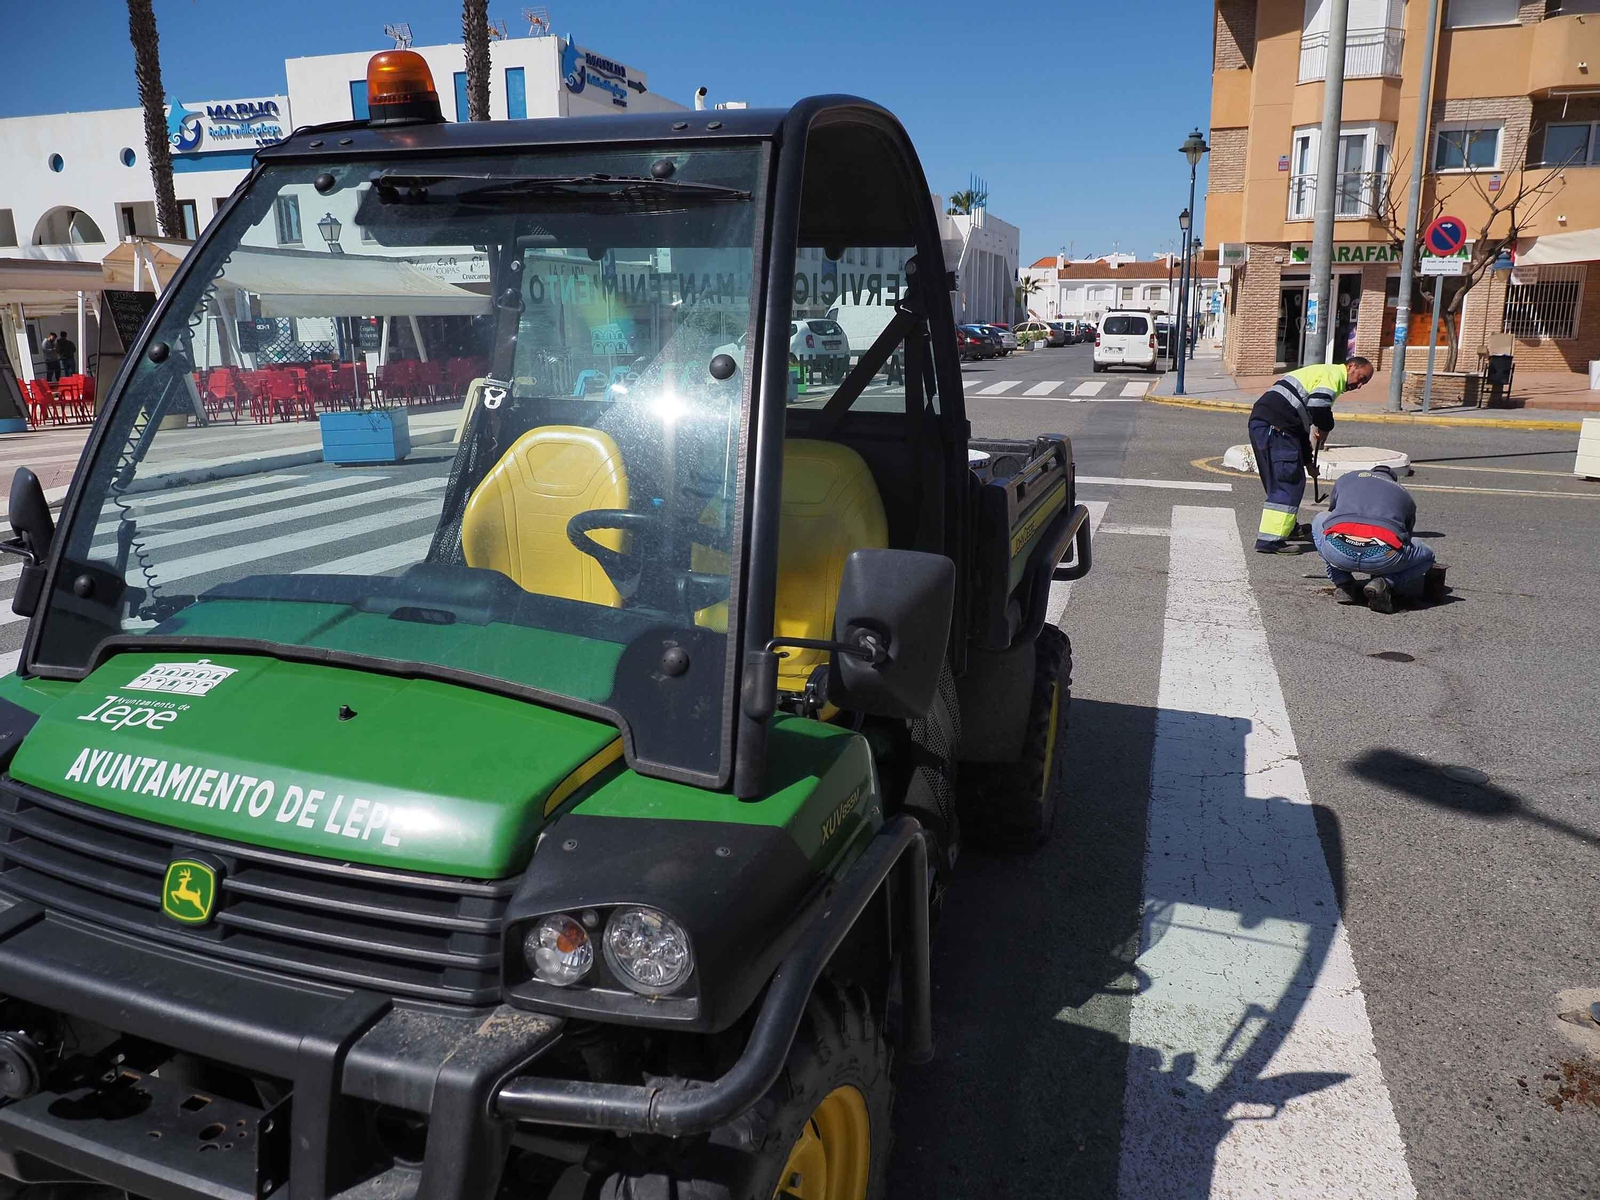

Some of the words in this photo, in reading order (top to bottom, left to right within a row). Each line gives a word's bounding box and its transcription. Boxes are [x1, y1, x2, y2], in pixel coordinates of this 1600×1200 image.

[436, 266, 461, 275] COPAS
[115, 696, 175, 709] Ayuntamiento
[177, 702, 191, 711] de
[64, 747, 275, 818] AYUNTAMIENTO
[275, 785, 326, 828] DE
